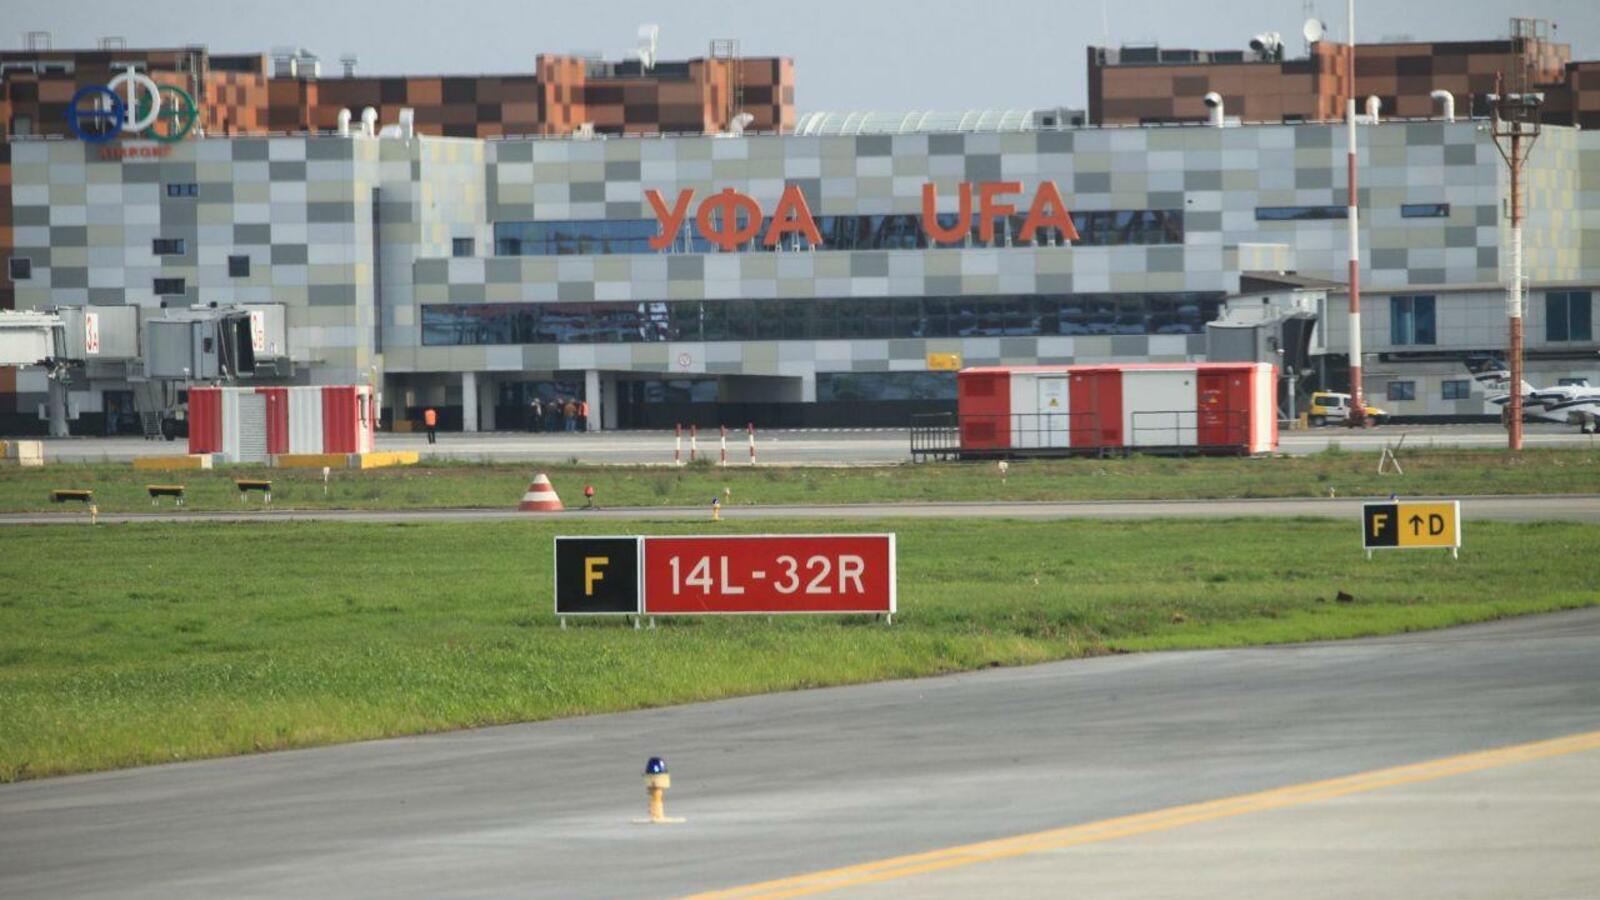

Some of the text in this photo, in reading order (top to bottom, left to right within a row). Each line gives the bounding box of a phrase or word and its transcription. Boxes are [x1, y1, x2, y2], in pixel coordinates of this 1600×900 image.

[644, 185, 823, 251] УФА
[922, 180, 1080, 243] UFA
[1373, 514, 1389, 537] F
[1429, 513, 1445, 536] D
[585, 557, 609, 596] F
[669, 554, 865, 595] 14L-32R
